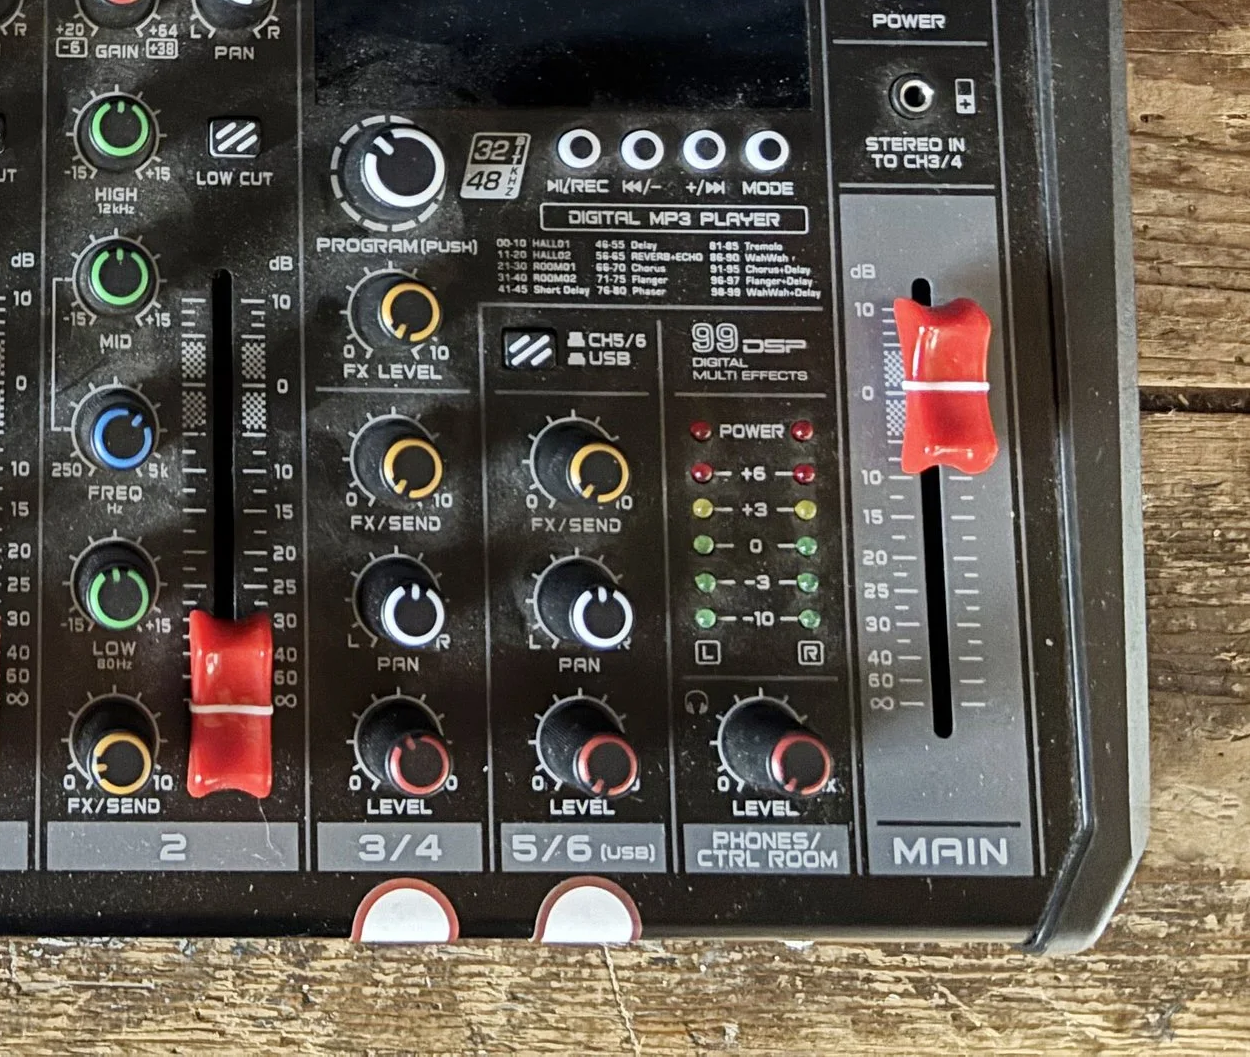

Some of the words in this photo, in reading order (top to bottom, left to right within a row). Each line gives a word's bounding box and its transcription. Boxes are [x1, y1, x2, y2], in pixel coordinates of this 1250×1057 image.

[872, 13, 946, 29] POWER
[95, 44, 139, 59] GAIN
[214, 46, 255, 60] PAN
[474, 140, 509, 160] 32
[865, 137, 942, 152] STEREO
[949, 138, 965, 152] IN
[871, 154, 898, 168] TO
[904, 154, 962, 169] CH3/4
[197, 171, 233, 185] LOW
[239, 172, 273, 186] CUT
[466, 171, 502, 190] 48
[95, 188, 137, 202] HIGH
[743, 180, 794, 195] MODE
[568, 210, 641, 226] DIGITAL
[650, 211, 691, 226] MP3
[701, 212, 780, 228] PLAYER
[630, 241, 657, 252] Delay
[744, 242, 783, 251] Tremolo
[11, 252, 35, 268] dB
[269, 256, 293, 271] dB
[745, 253, 789, 263] WahWah
[631, 264, 666, 274] Chorus
[745, 265, 811, 276] Chorus+Delay
[851, 265, 875, 279] dB
[632, 275, 668, 287] Flanger
[746, 276, 813, 287] Flanger+Delay
[13, 290, 32, 306] 10
[533, 285, 561, 294] Short
[563, 285, 590, 297] Delay
[746, 288, 821, 299] WahWah+Delay
[855, 303, 874, 317] 10
[100, 334, 132, 349] MID
[589, 333, 646, 348] CH5/6
[692, 323, 739, 353] 99
[742, 339, 807, 353] DSP
[430, 345, 449, 361] 10
[589, 352, 631, 365] USB
[693, 358, 748, 368] DIGITAL
[343, 363, 369, 379] FX
[378, 364, 442, 380] LEVEL
[693, 370, 737, 381] MULTI
[741, 371, 808, 381] EFFECTS
[720, 424, 784, 439] POWER
[10, 461, 30, 476] 10
[51, 462, 82, 477] 250
[741, 466, 766, 481] +6
[88, 486, 143, 502] FREQ
[10, 501, 30, 517] 15
[742, 502, 767, 517] +3
[350, 515, 441, 531] FX/SEND
[531, 518, 622, 533] FX/SEND
[7, 543, 31, 559] 20
[863, 552, 887, 566] 20
[7, 577, 31, 592] 25
[6, 611, 30, 626] 30
[866, 618, 891, 632] 30
[7, 645, 30, 661] 40
[93, 641, 136, 656] LOW
[378, 657, 419, 671] PAN
[559, 658, 600, 672] PAN
[6, 669, 30, 684] 60
[68, 798, 160, 815] FX/SEND
[367, 800, 432, 815] LEVEL
[551, 800, 615, 816] LEVEL
[732, 800, 800, 816] LEVEL
[160, 833, 187, 861] 2
[713, 831, 821, 850] PHONES/
[359, 835, 442, 862] 3/4
[512, 835, 592, 862] 5/6
[894, 838, 1008, 866] MAIN
[698, 850, 760, 868] CTRL
[768, 852, 838, 868] ROOM
